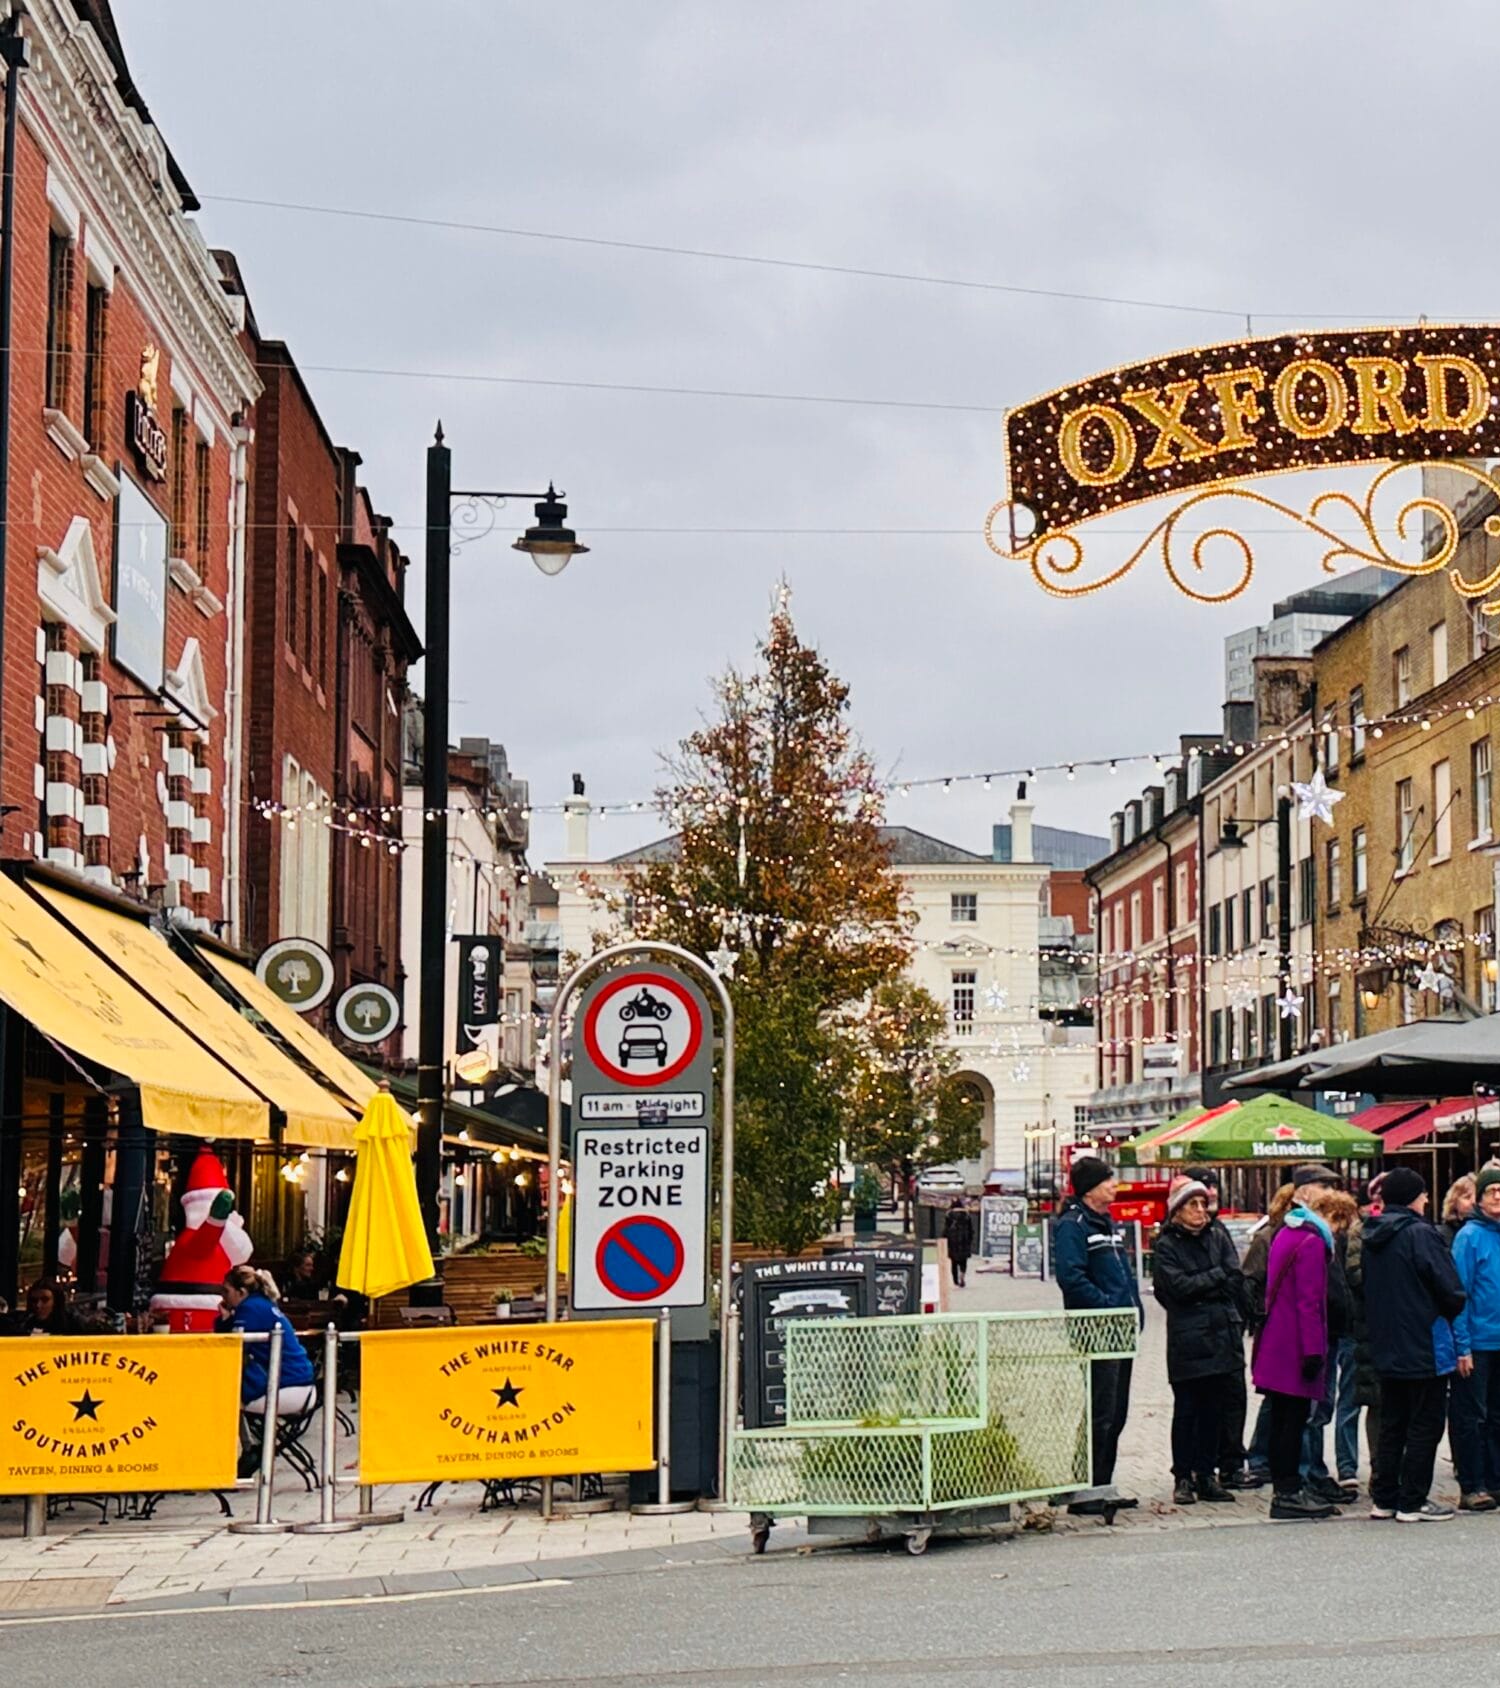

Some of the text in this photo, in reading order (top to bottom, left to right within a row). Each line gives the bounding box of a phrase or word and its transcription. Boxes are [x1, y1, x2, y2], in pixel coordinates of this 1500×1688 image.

[1058, 352, 1491, 487] OXFORD
[584, 1137, 700, 1156] Restricted
[1252, 1141, 1325, 1156] Heineken
[600, 1161, 684, 1180] Parking
[598, 1185, 682, 1207] ZONE
[755, 1261, 864, 1278] THE WHITE STAR
[14, 1351, 158, 1387] THE WHITE STAR
[438, 1340, 574, 1378] THE WHITE STAR
[438, 1402, 576, 1444] SOUTHAMPTON
[12, 1415, 158, 1458] SOUTHAMPTON
[60, 1464, 102, 1475] DINING
[118, 1463, 159, 1473] ROOMS
